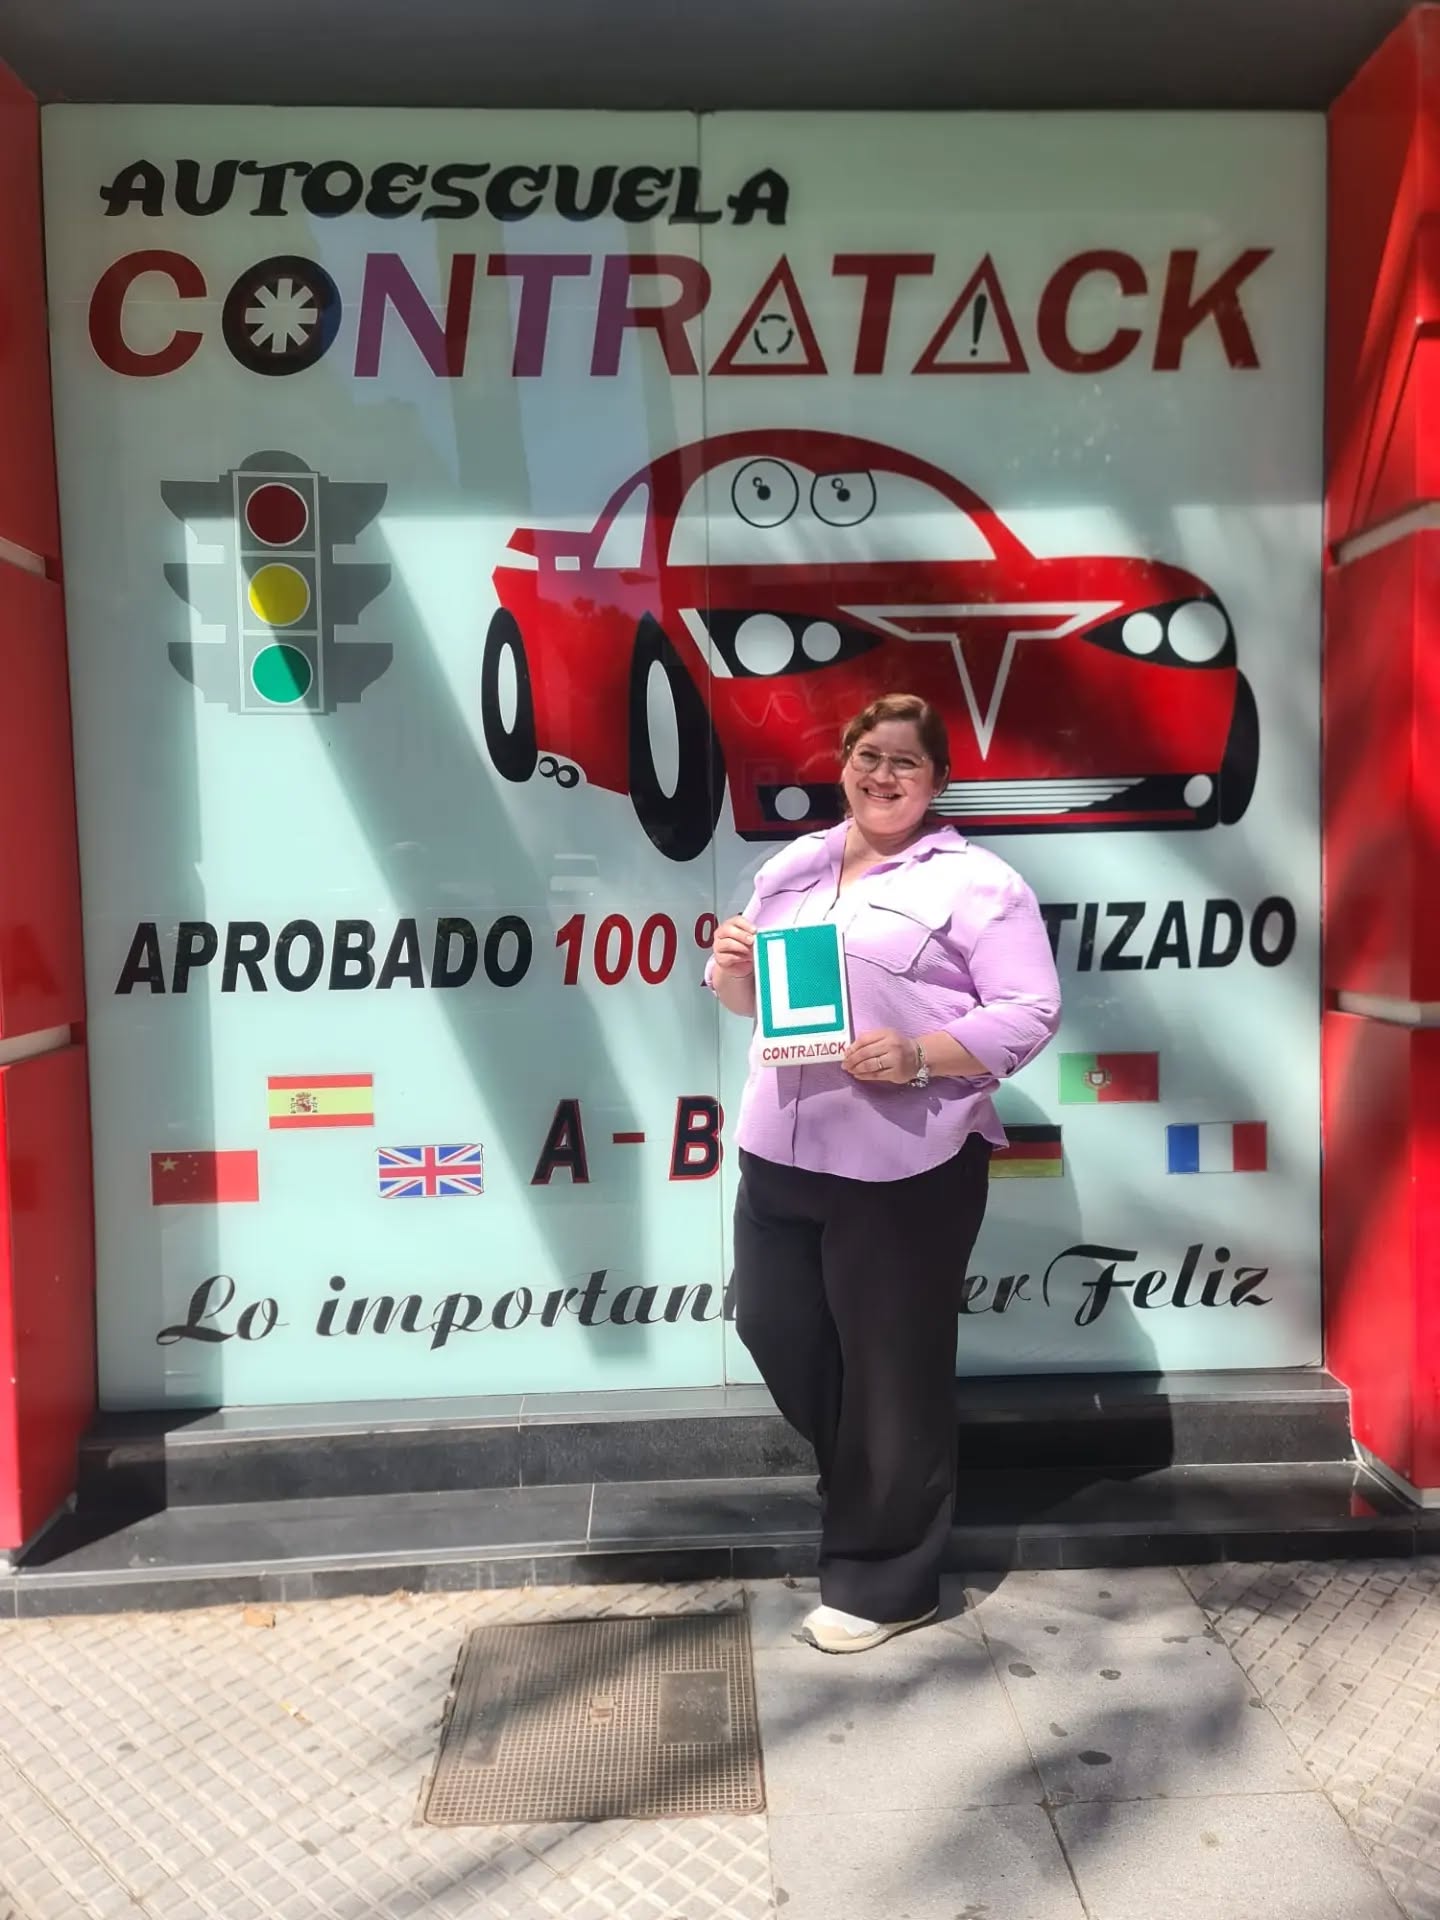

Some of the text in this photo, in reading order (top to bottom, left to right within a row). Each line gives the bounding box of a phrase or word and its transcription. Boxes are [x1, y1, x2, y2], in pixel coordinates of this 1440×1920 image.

[99, 157, 791, 226] AUTOESCUELA
[88, 248, 1275, 378] CONTRATACK
[114, 915, 534, 994] APROBADO
[554, 912, 679, 986] 100
[1038, 896, 1297, 972] TIZADO
[766, 938, 837, 1030] L
[762, 1041, 847, 1061] CONTRATACK
[530, 1098, 590, 1185] A
[668, 1095, 725, 1181] B
[155, 1243, 1273, 1351] Lo important er Feliz
